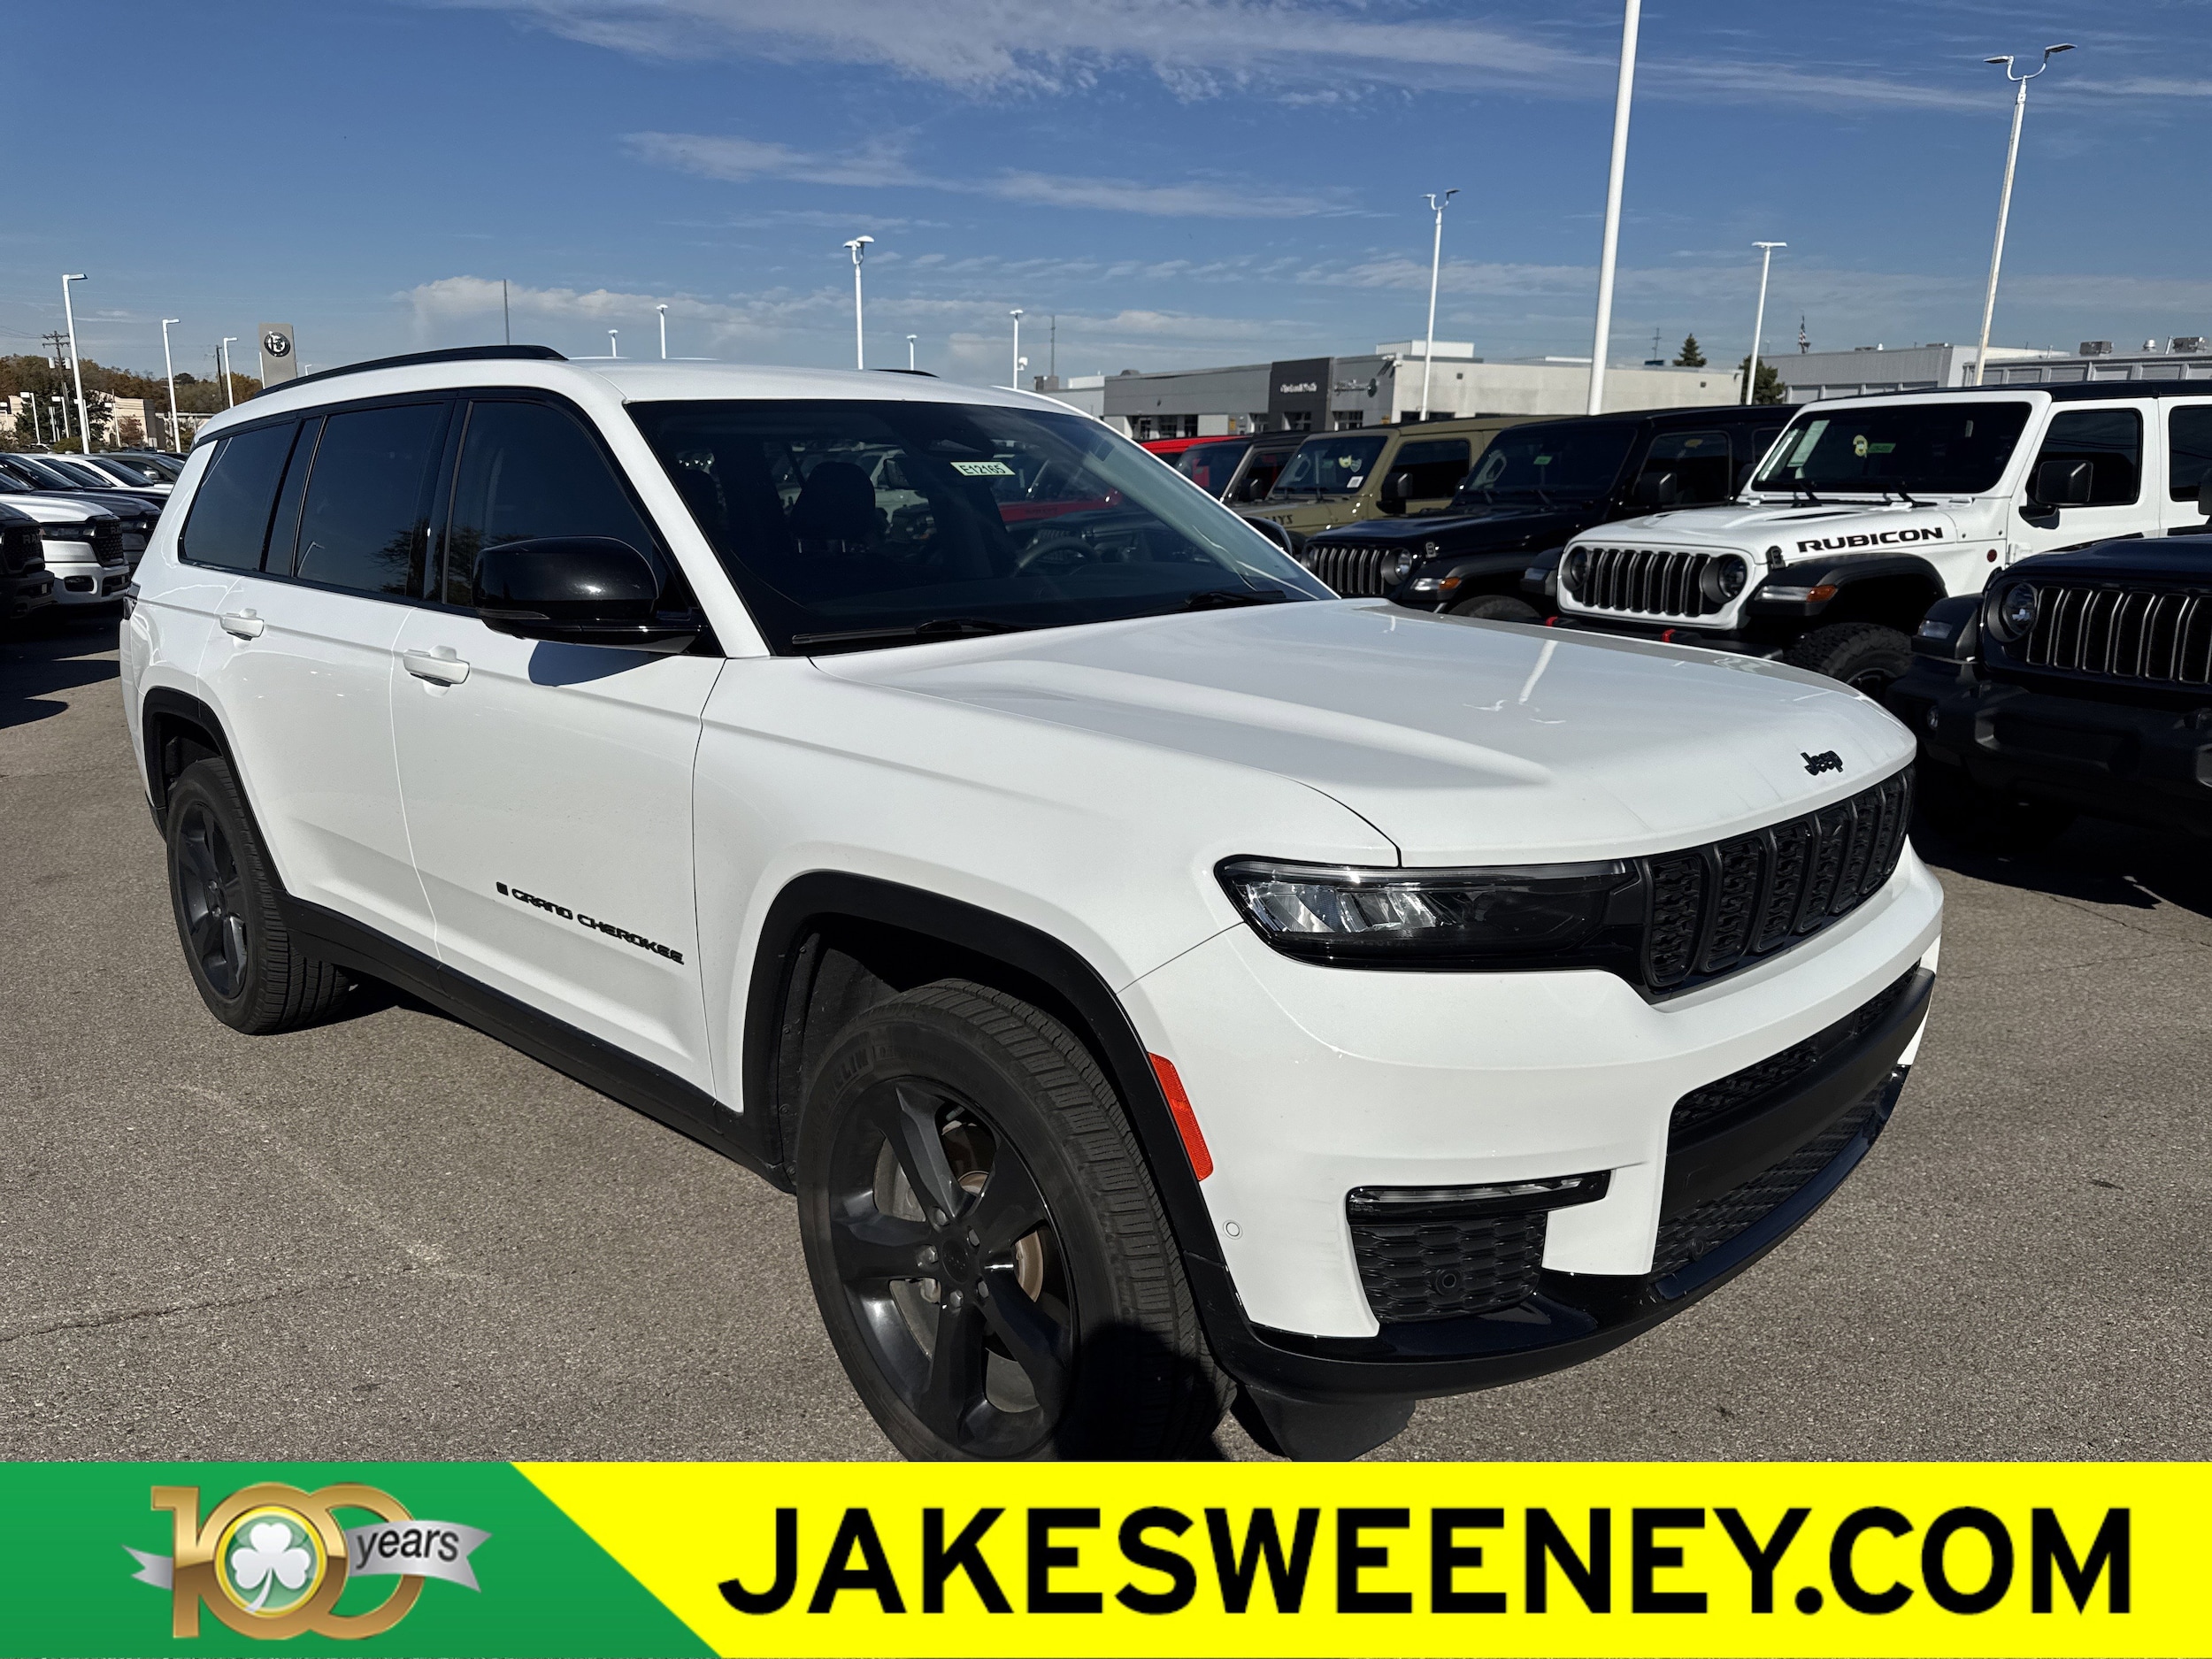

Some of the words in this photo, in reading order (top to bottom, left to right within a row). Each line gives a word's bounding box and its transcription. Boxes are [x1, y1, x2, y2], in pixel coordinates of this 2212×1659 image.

[958, 465, 1006, 474] E12165
[1796, 526, 1944, 553] RUBICON
[1800, 750, 1844, 776] Jeep
[511, 888, 573, 920] GRAND
[577, 913, 685, 965] CHEROKEE
